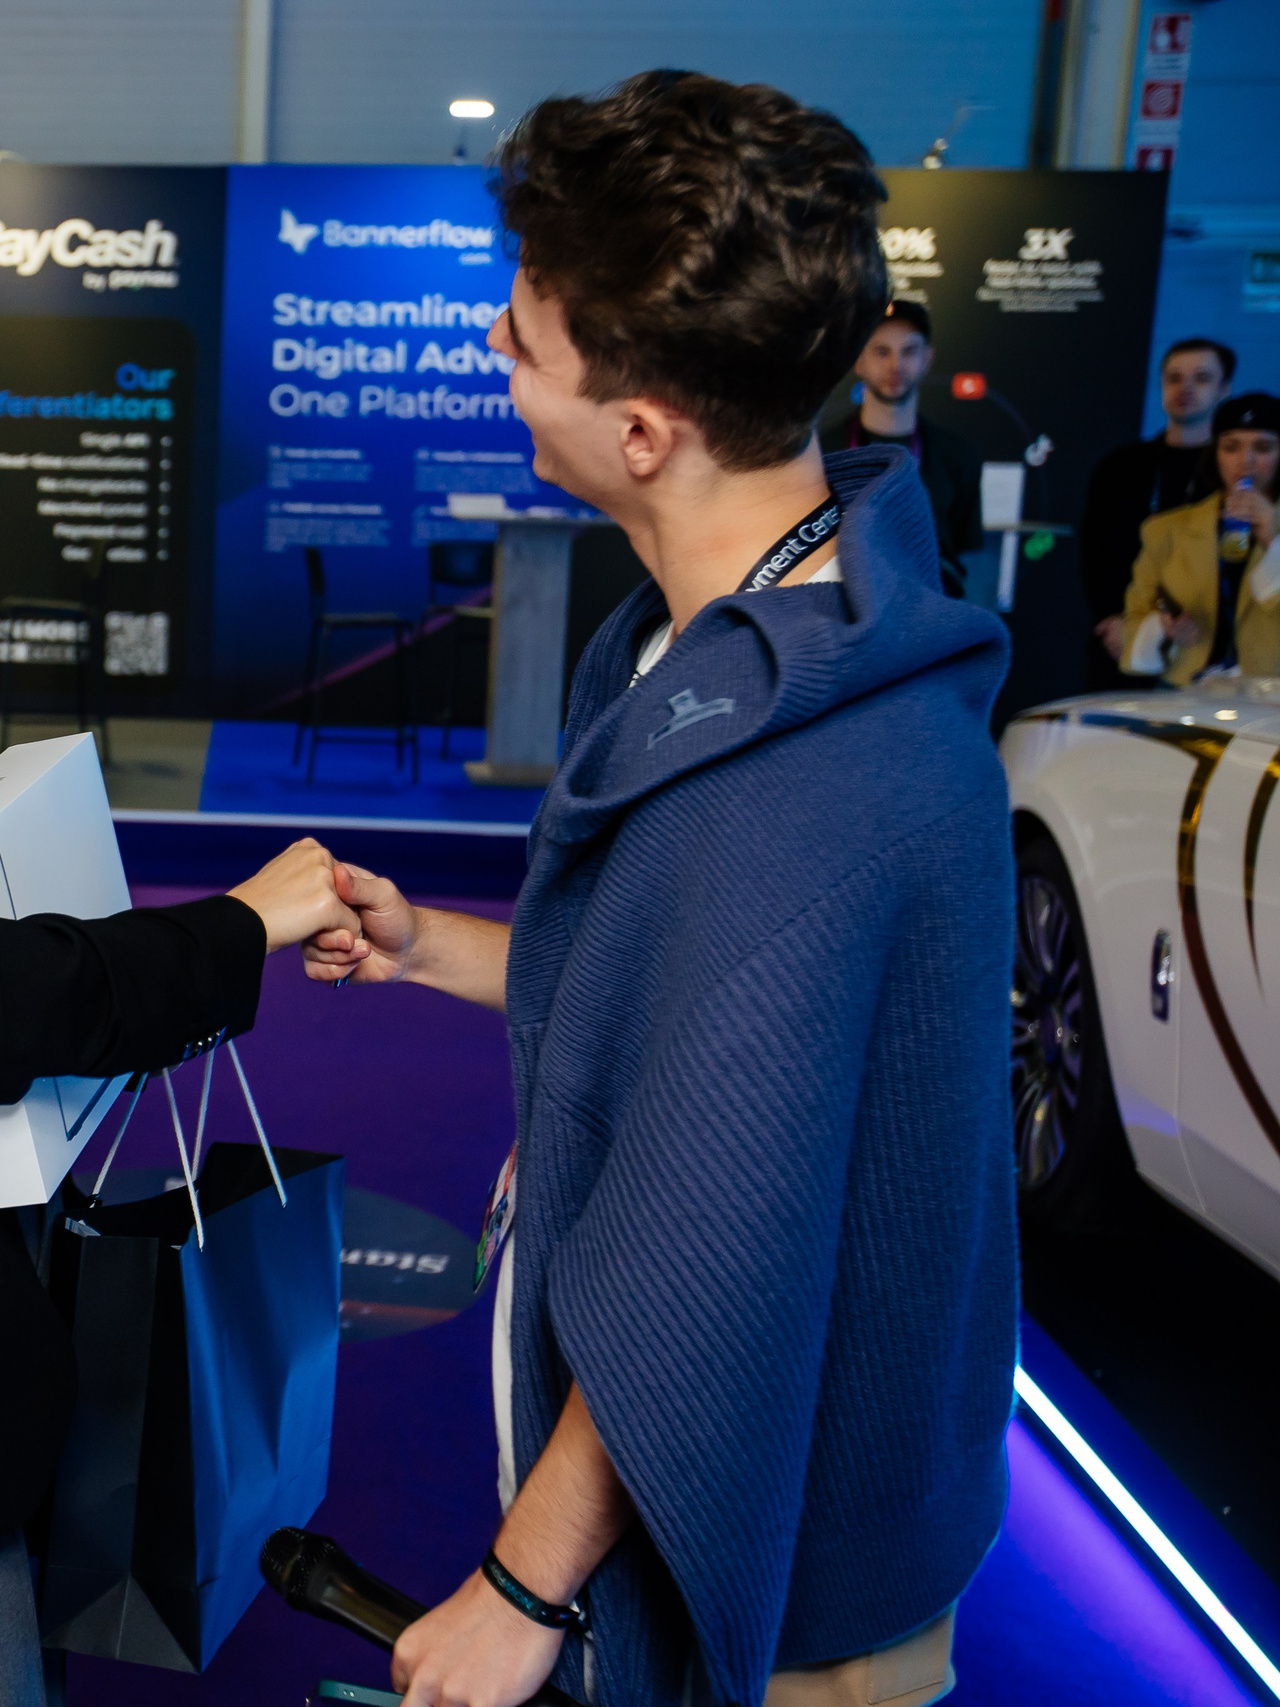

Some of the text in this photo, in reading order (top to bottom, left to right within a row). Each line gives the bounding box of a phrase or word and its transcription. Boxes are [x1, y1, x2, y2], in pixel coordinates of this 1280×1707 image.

[322, 219, 496, 249] Bannerflow
[877, 226, 937, 260] 0%
[272, 337, 407, 380] Digital
[115, 362, 176, 391] Our
[270, 383, 523, 420] One Platform
[745, 538, 808, 592] yment
